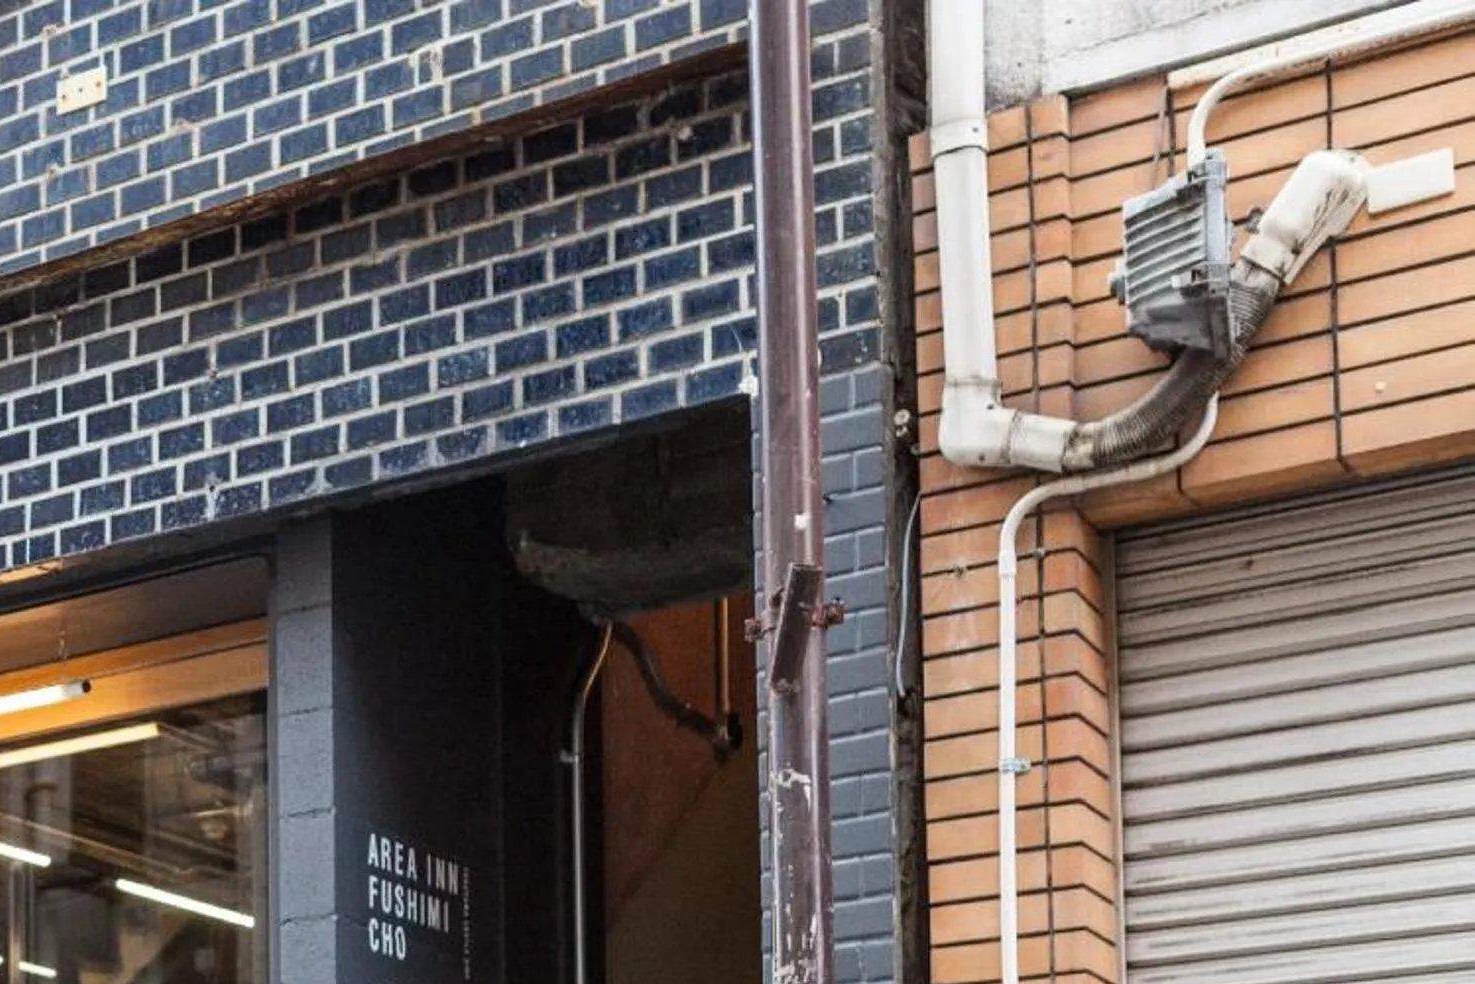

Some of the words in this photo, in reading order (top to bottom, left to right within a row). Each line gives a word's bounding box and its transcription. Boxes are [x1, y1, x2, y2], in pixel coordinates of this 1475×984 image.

[368, 833, 417, 880] AREA
[427, 853, 459, 895] INN
[368, 875, 449, 933] FUSHIMI
[368, 918, 406, 960] CHO
